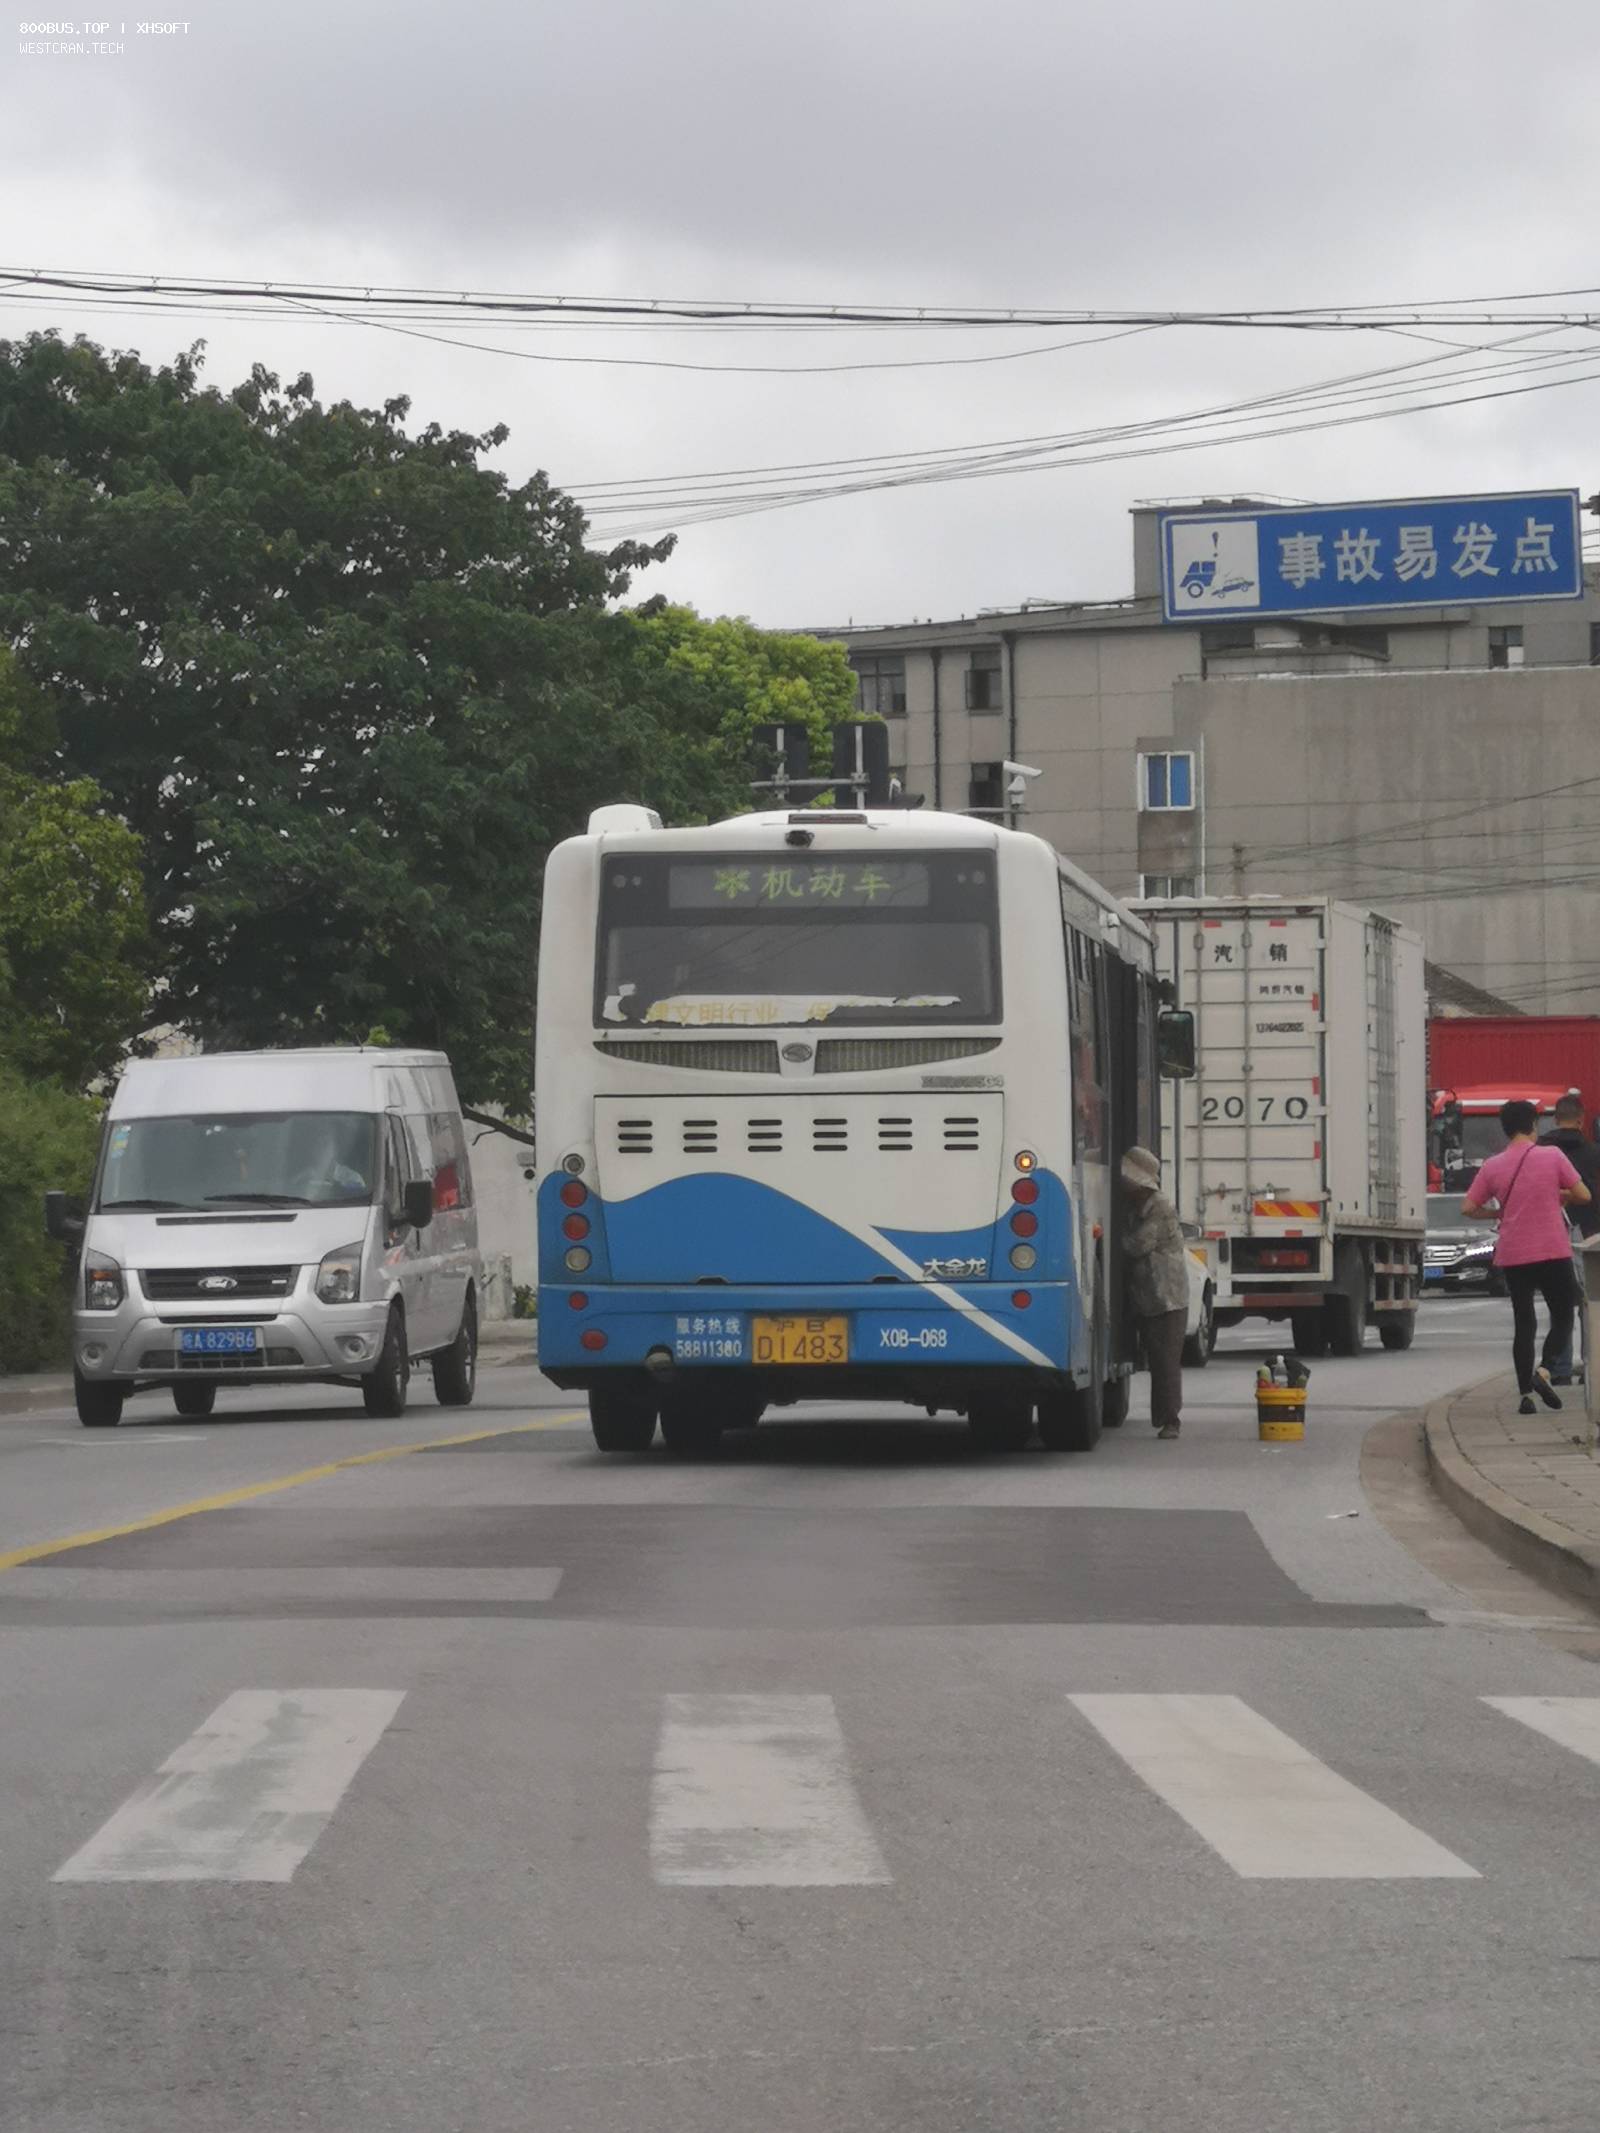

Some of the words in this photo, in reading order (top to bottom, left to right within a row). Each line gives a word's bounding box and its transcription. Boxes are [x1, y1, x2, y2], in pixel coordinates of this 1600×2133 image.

[1277, 517, 1559, 590] 事故易发点
[1202, 1096, 1309, 1122] 2070
[923, 1258, 987, 1278] 大金龙
[758, 1335, 843, 1361] D1483
